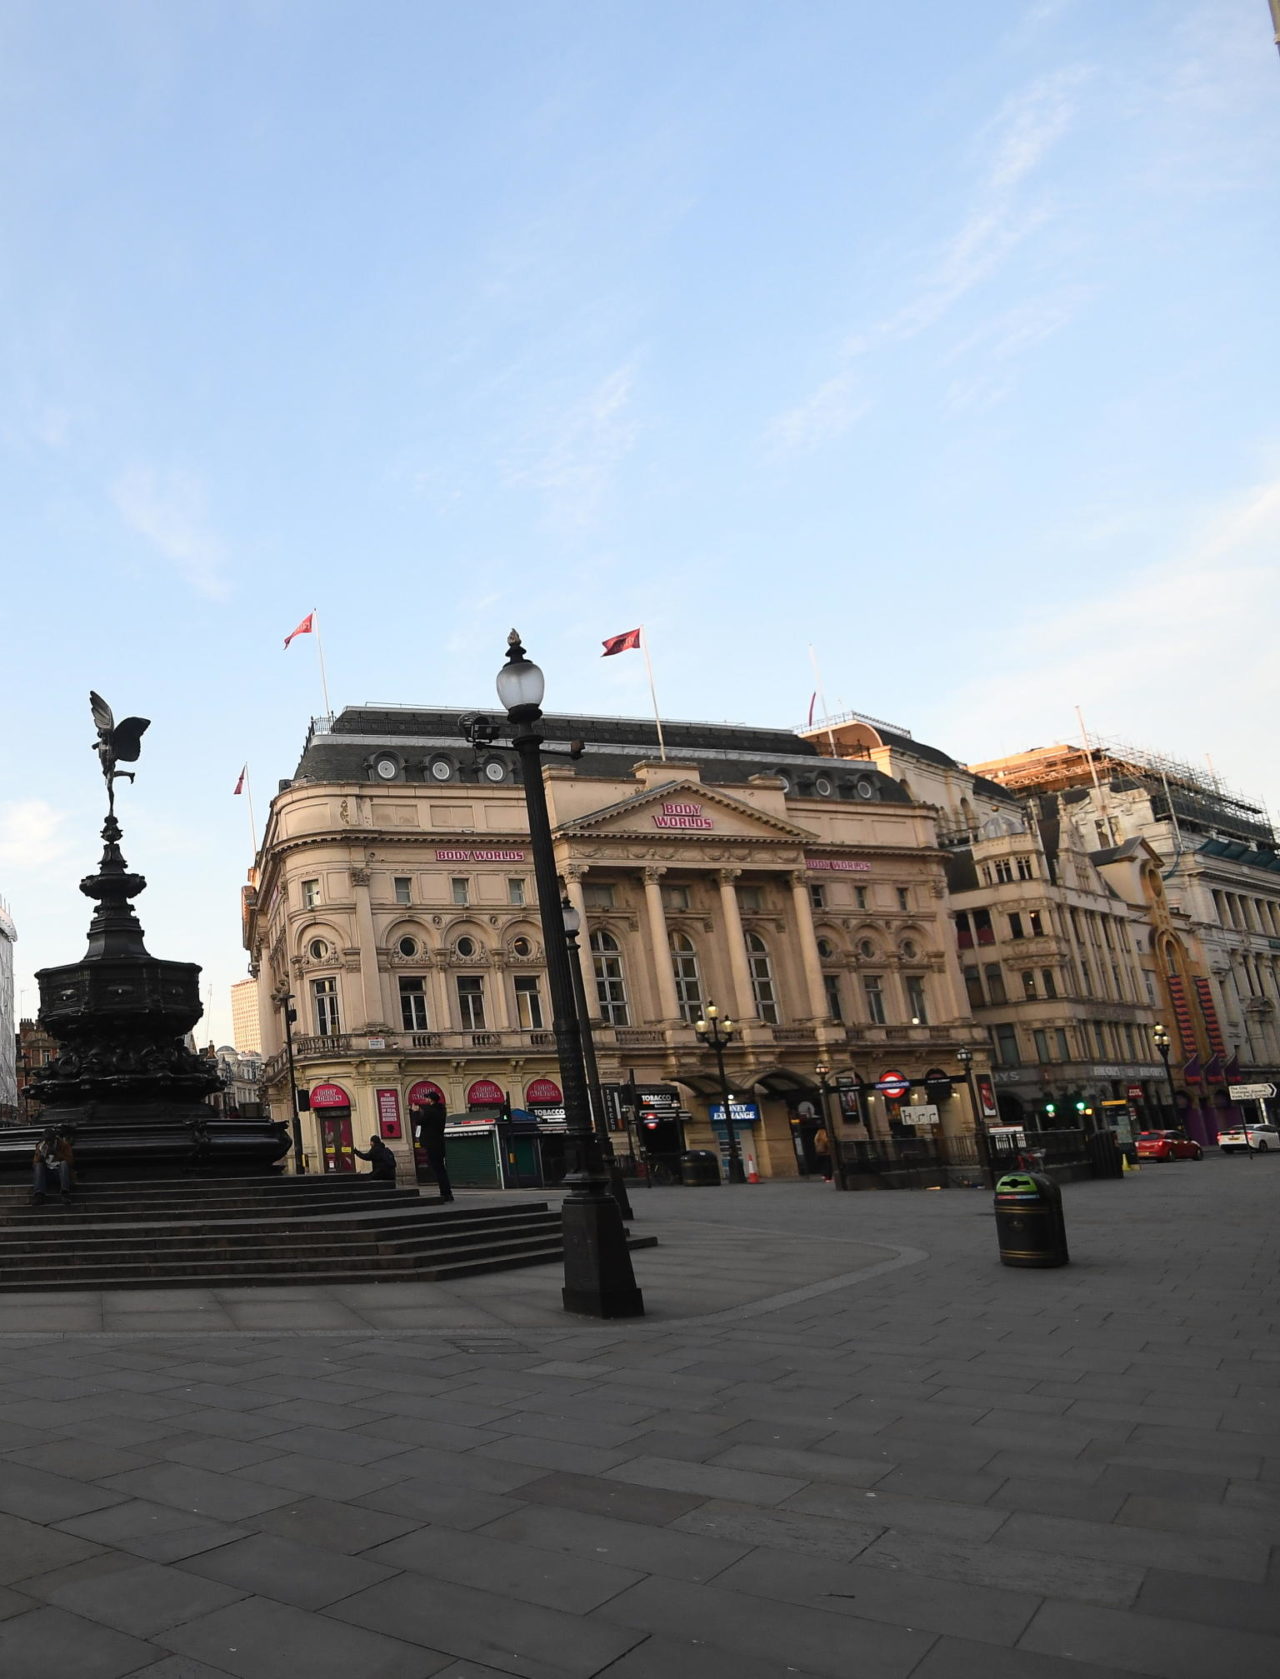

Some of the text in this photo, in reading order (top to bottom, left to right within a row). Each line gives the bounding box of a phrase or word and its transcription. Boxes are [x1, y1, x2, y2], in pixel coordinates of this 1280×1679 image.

[663, 803, 702, 815] BODY
[653, 816, 712, 829] WORLDS
[435, 850, 525, 861] BODY WORLDS
[831, 860, 872, 871] WORLDS
